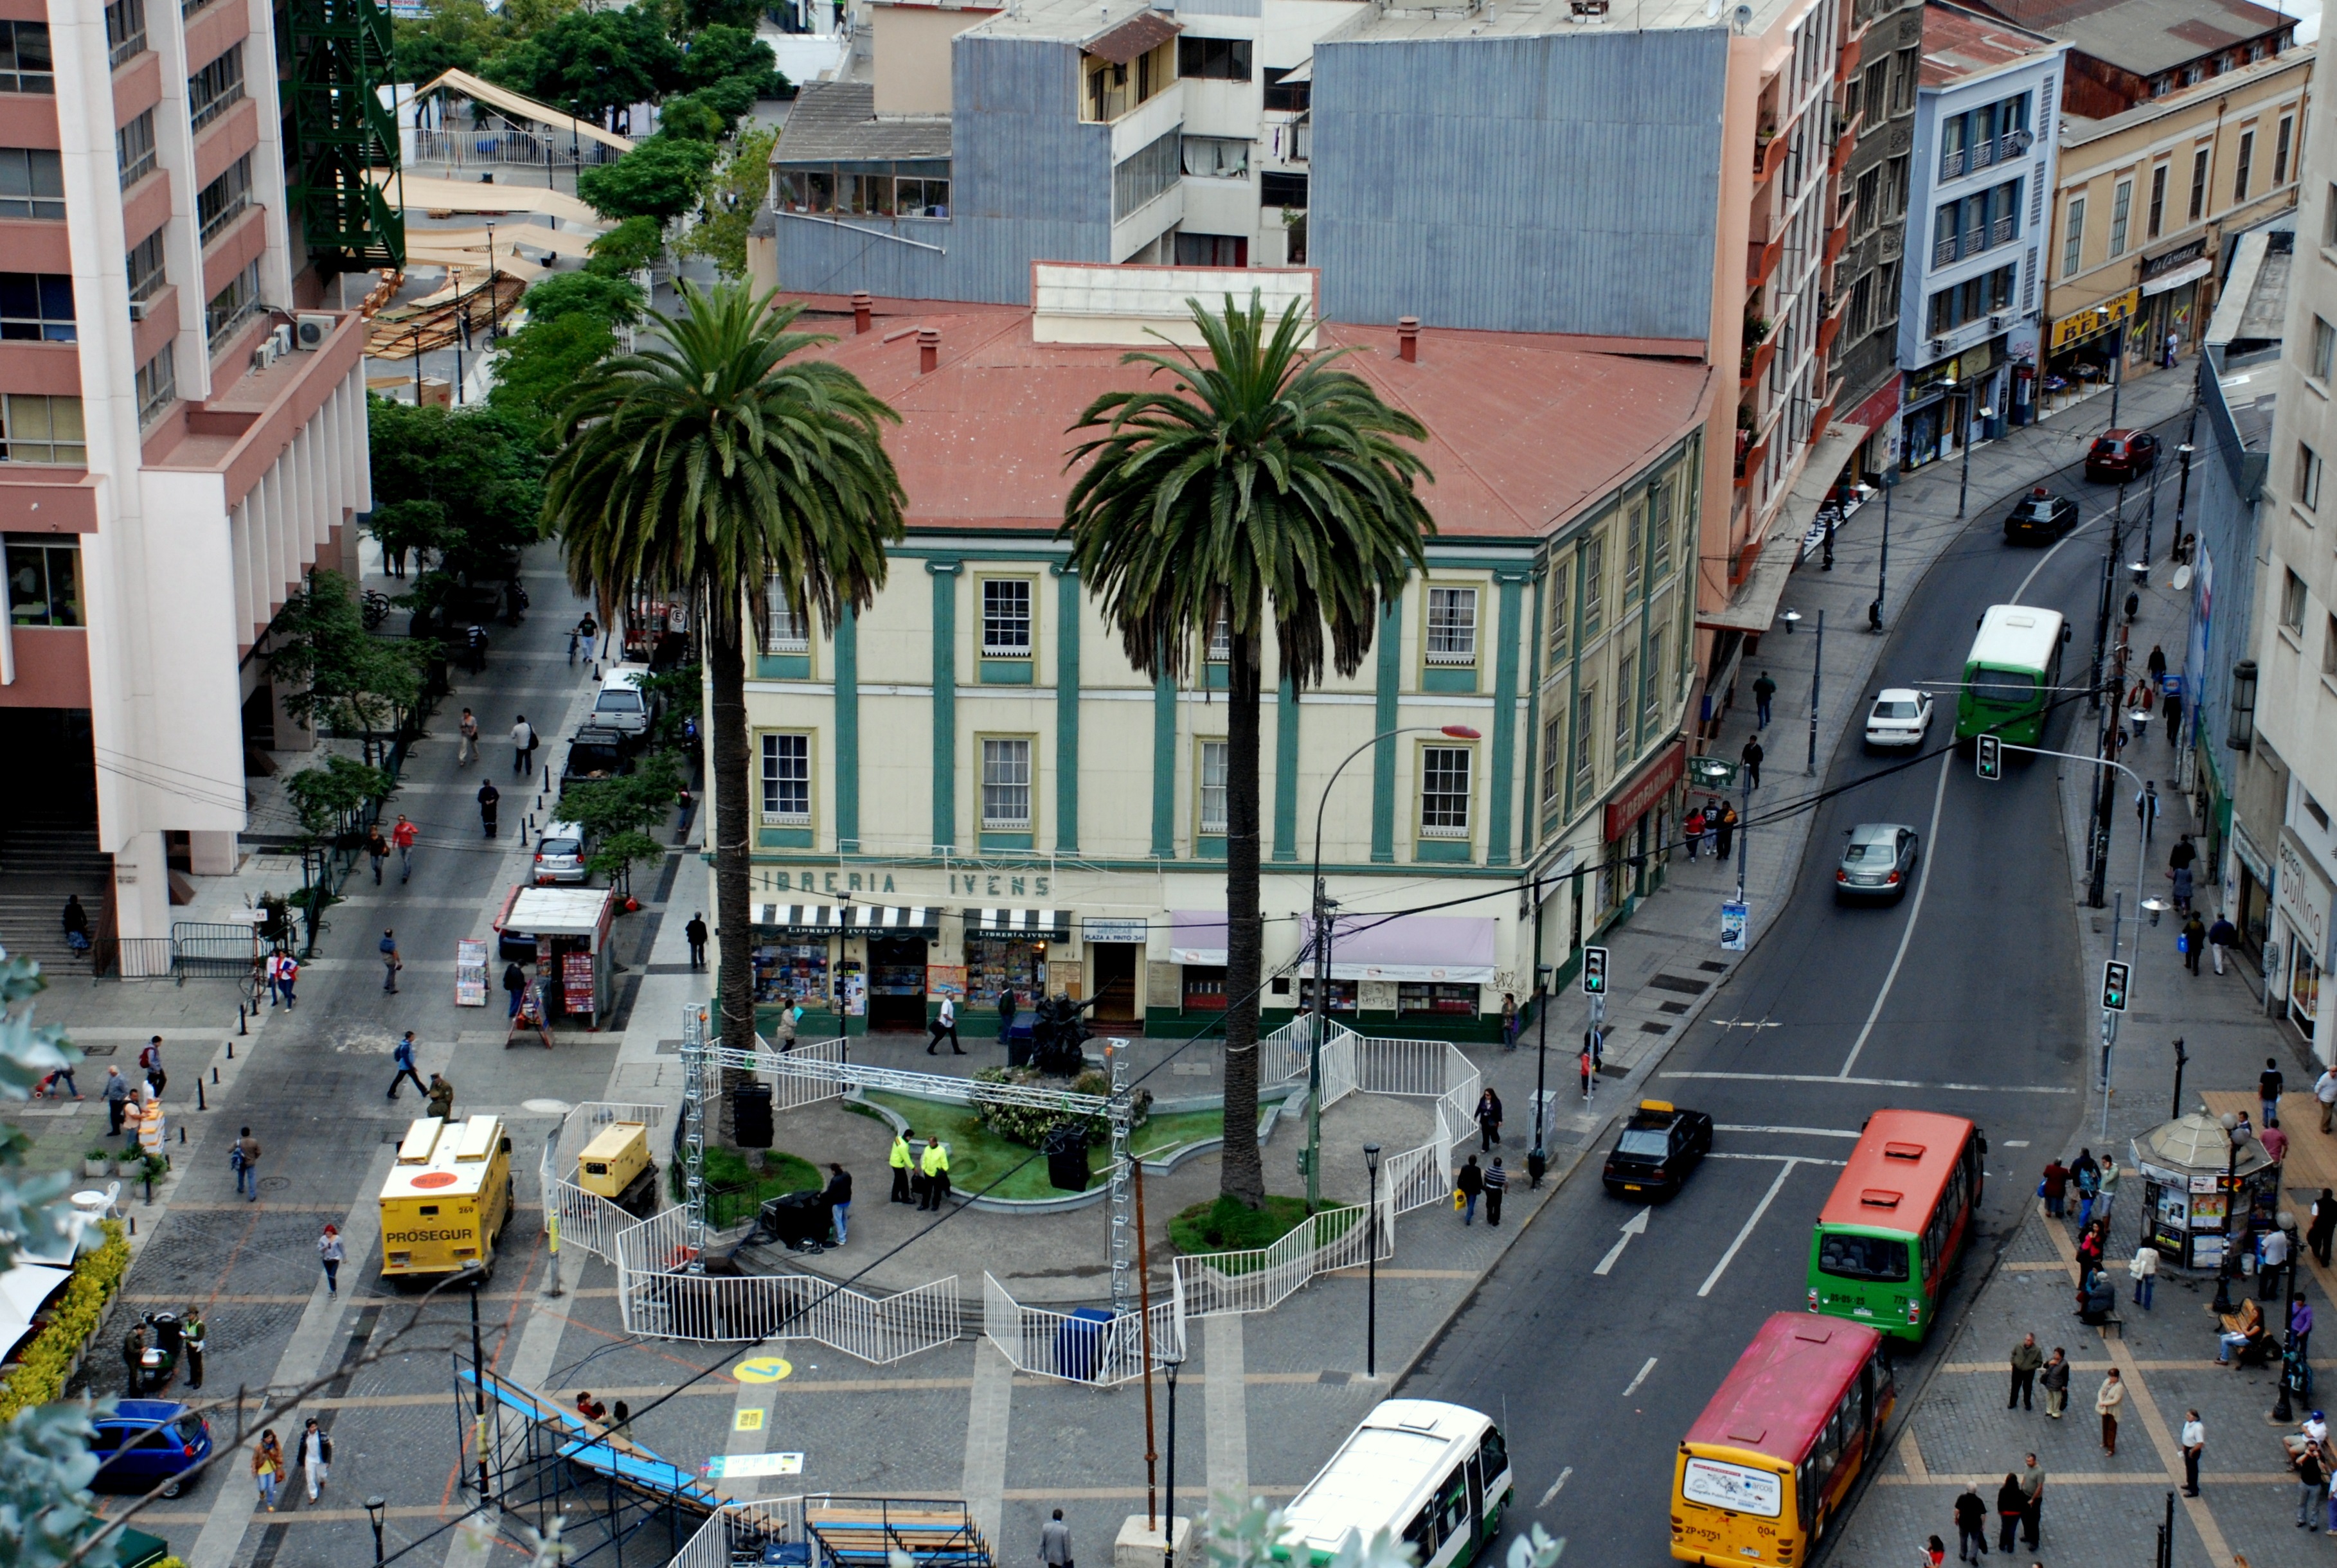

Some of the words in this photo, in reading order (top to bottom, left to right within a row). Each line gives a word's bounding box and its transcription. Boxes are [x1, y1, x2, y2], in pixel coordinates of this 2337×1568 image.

[2064, 294, 2128, 326] CALZDOS
[750, 871, 895, 893] IBRERIA
[949, 874, 1049, 896] IVENS
[2282, 860, 2321, 956] bulling
[386, 1229, 472, 1243] PROSEGUR
[1894, 1295, 1907, 1305] 773
[1751, 1482, 1773, 1493] arcos
[1757, 1526, 1776, 1537] 004
